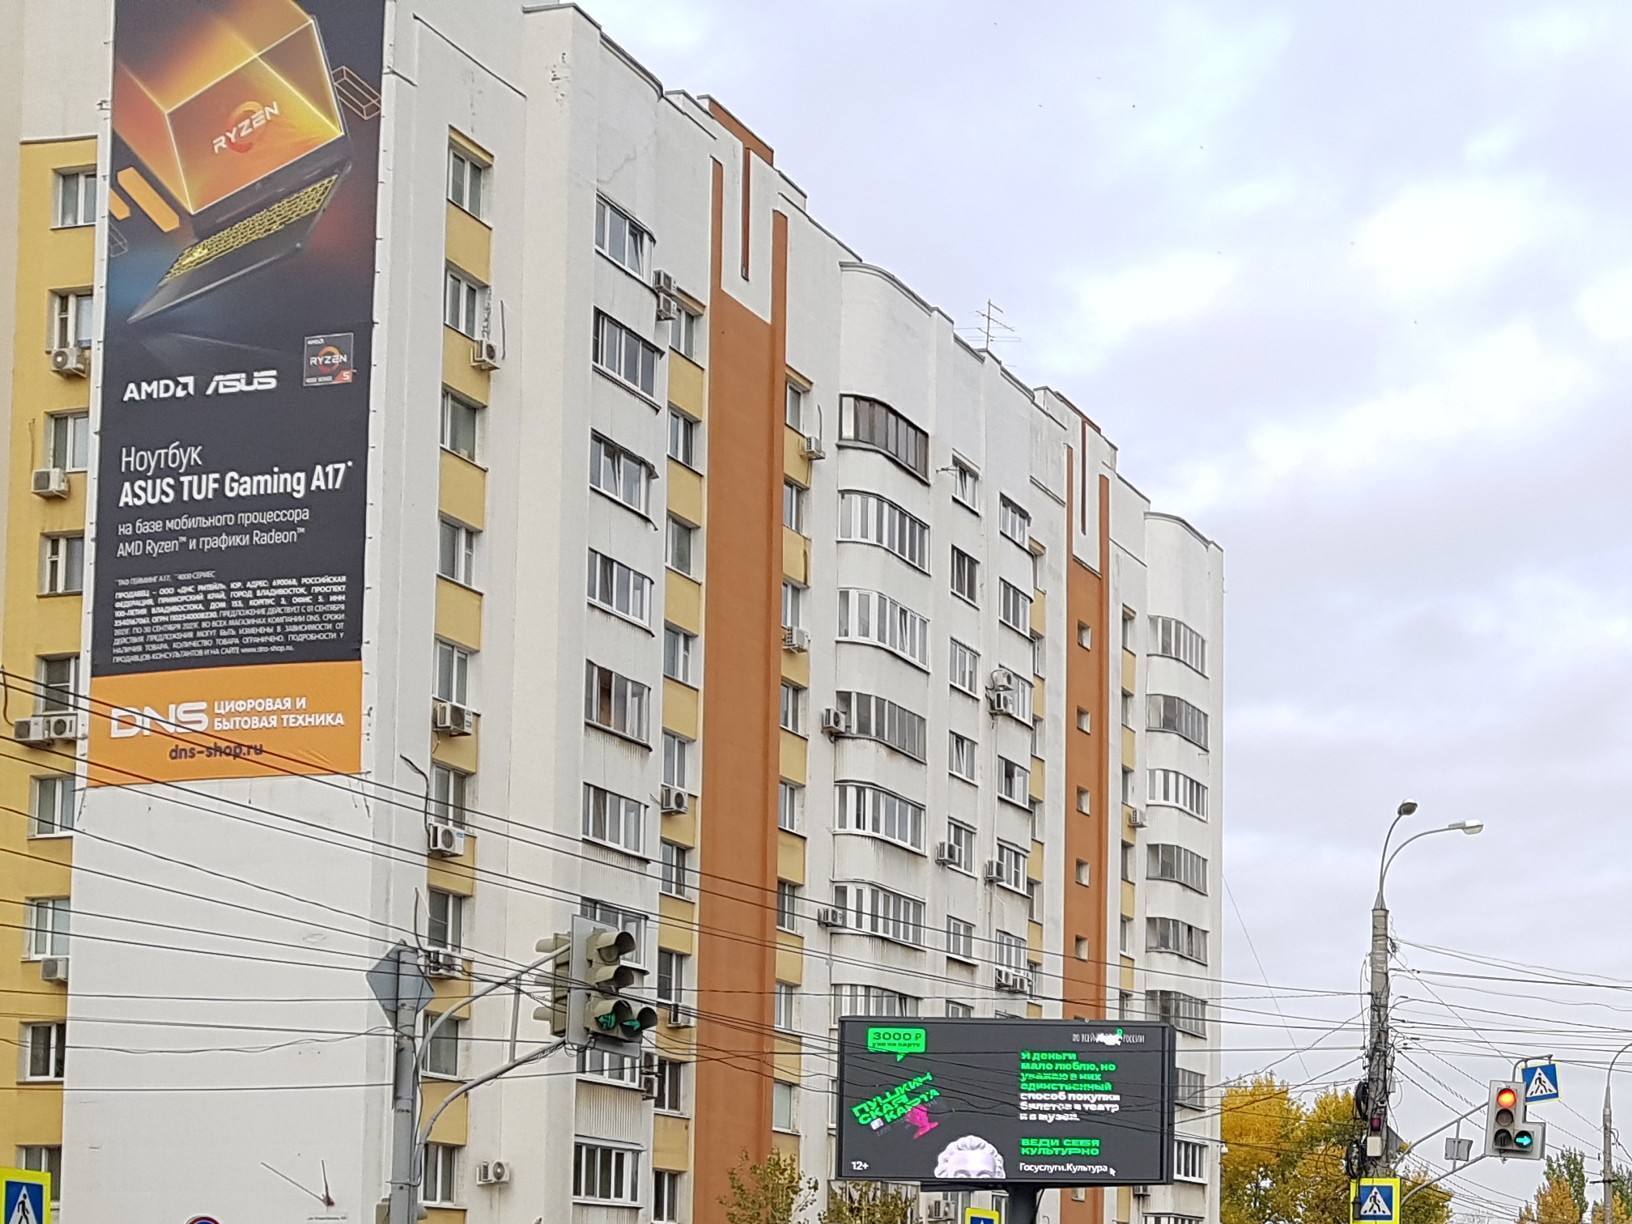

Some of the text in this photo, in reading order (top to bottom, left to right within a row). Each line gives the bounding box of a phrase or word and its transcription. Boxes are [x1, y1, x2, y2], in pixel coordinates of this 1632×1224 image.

[212, 100, 280, 154] RYZEN
[309, 354, 347, 366] RYZEN
[122, 370, 278, 401] AMD ASUS
[122, 441, 202, 476] Ноутбук
[118, 477, 175, 507] ASUS
[180, 473, 220, 501] TUF
[224, 466, 306, 499] Gaming
[118, 507, 310, 536] на базе мобильного процессора
[116, 542, 143, 558] AMD
[189, 539, 197, 550] и
[199, 532, 251, 552] графики
[214, 698, 307, 714] ЦИФРОВАЯ И
[110, 702, 208, 738] DNS
[214, 713, 345, 731] БЫТОВАЯ ТЕХНИКА
[170, 743, 263, 761] dns-shop.ru
[873, 1032, 912, 1040] 3000
[1032, 1053, 1077, 1061] деньги
[1054, 1061, 1099, 1072] люблю,
[1100, 1063, 1117, 1071] но
[1020, 1092, 1121, 1103] способ покупки
[1083, 1103, 1120, 1113] театр
[1021, 1139, 1100, 1147] ВЕДИ СЕБЯ
[1021, 1148, 1100, 1156] КУЛЬТУРНО
[851, 1162, 869, 1171] 12+
[1020, 1162, 1108, 1174] Госуслуги.Культура
